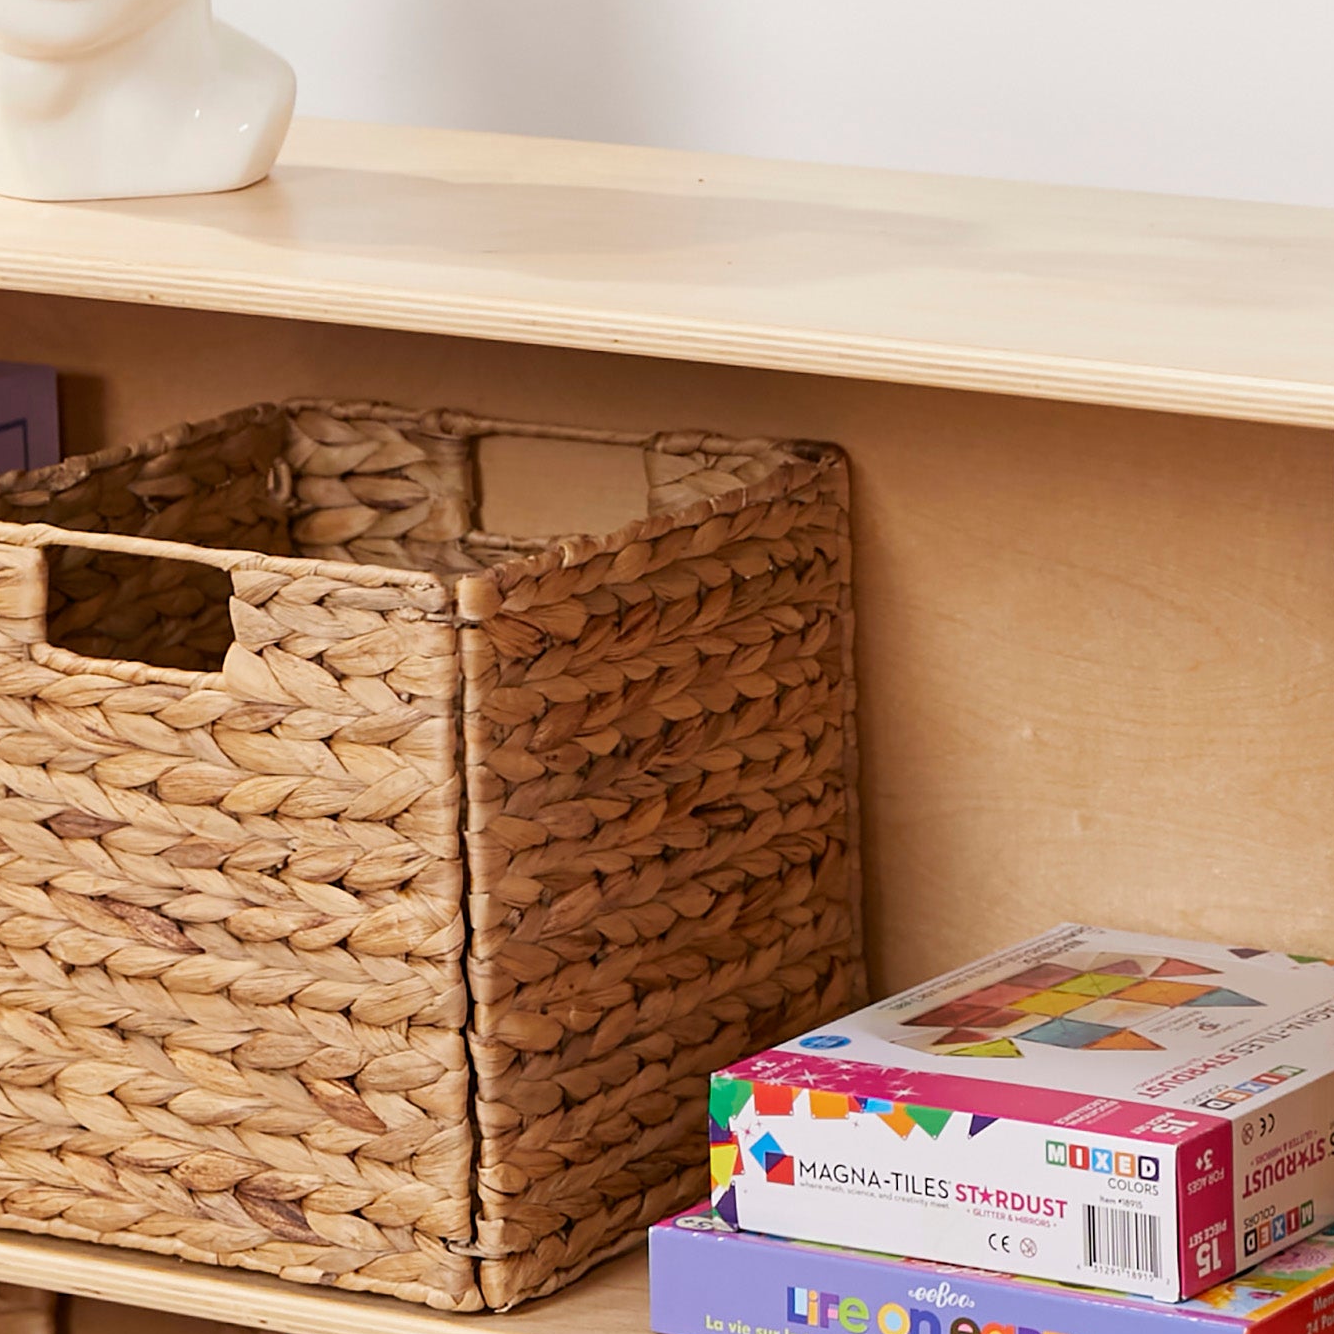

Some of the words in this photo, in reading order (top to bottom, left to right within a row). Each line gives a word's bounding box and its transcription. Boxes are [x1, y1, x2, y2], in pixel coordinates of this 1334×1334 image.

[799, 1160, 950, 1200] MAGNA-TILES
[1046, 1140, 1160, 1182] MIXED
[1108, 1178, 1159, 1196] COLORS
[1196, 1237, 1222, 1278] 15
[705, 1315, 724, 1330] La
